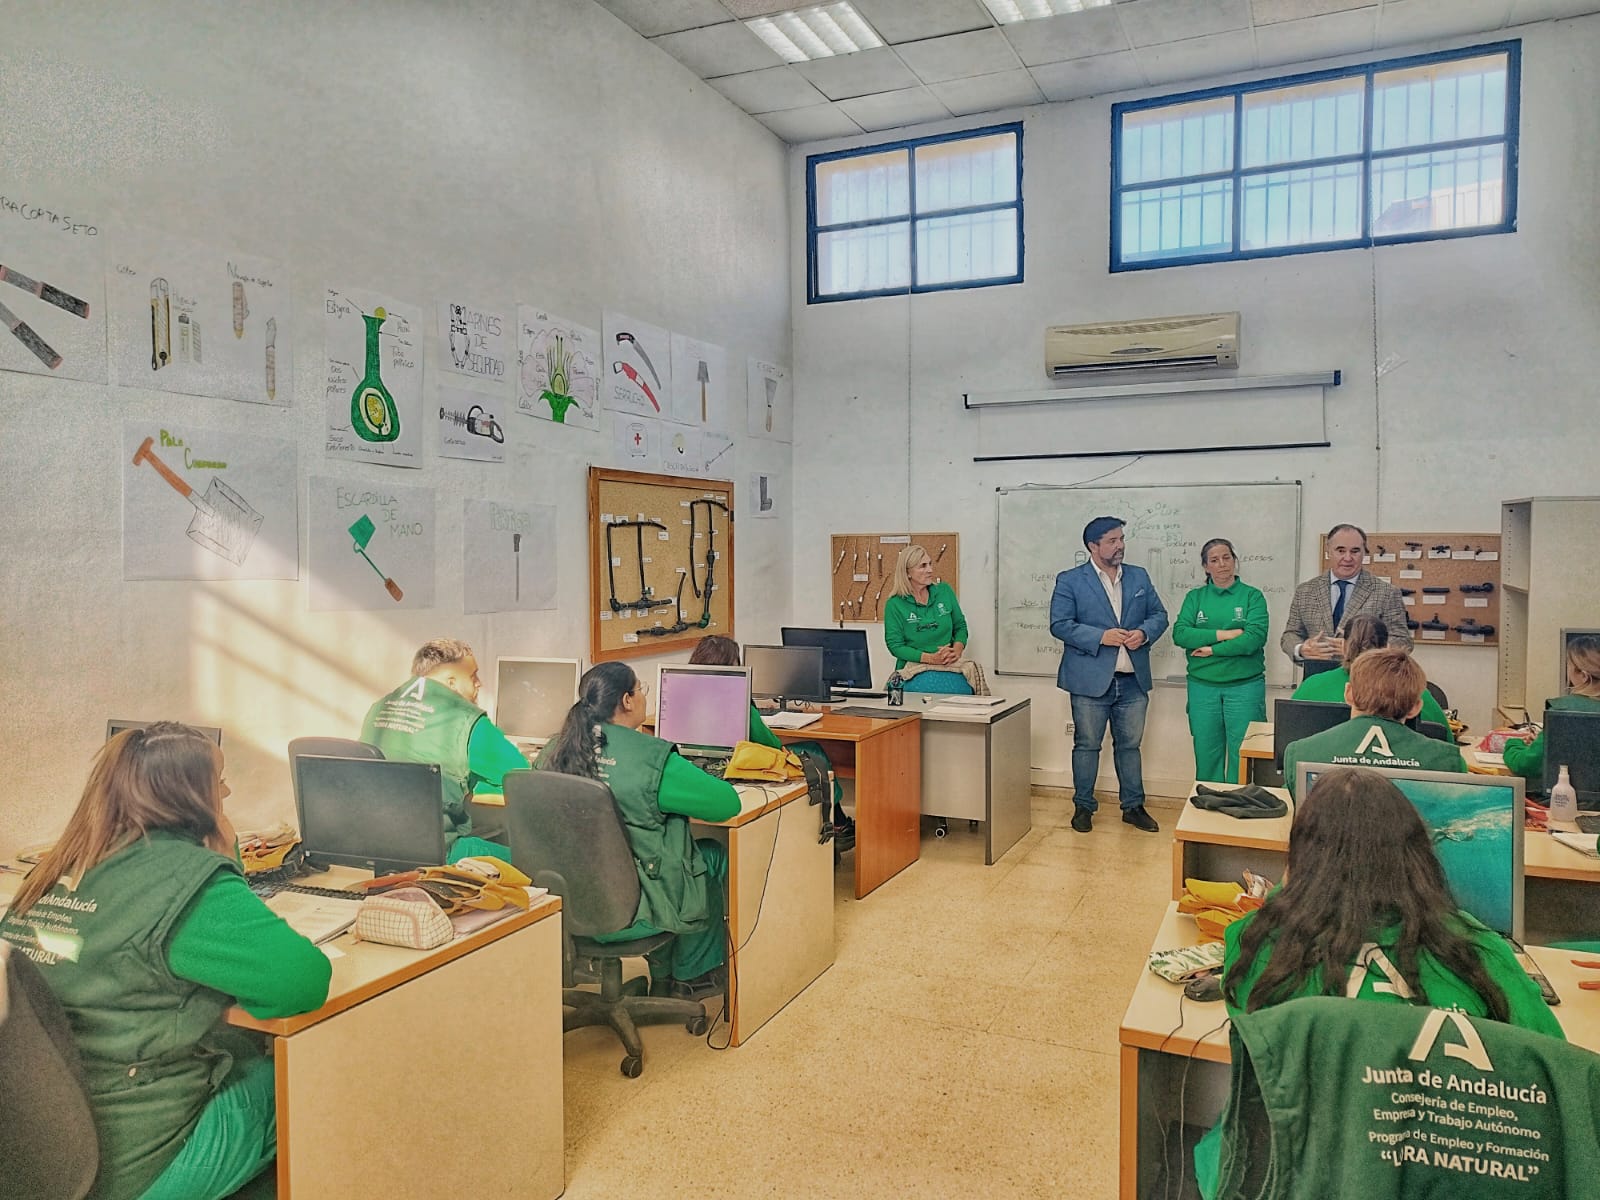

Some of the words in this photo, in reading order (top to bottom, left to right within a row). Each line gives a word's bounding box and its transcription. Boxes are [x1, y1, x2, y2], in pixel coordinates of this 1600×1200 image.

[61, 216, 99, 236] SETO
[473, 333, 489, 349] DE
[381, 508, 400, 523] DE
[390, 522, 424, 538] MANO
[1331, 756, 1358, 764] Junta
[1359, 756, 1372, 765] de
[1373, 758, 1421, 767] Andalucía
[46, 894, 98, 913] Andalucía
[1361, 1066, 1413, 1085] Junta
[1418, 1070, 1443, 1089] de
[1446, 1074, 1547, 1105] Andalucía
[1391, 1092, 1447, 1109] Consejería
[1450, 1099, 1466, 1112] de
[1468, 1102, 1519, 1122] Empleo,
[1418, 1110, 1425, 1121] y
[1427, 1111, 1473, 1130] Trabajo
[1475, 1119, 1541, 1140] Autónomo
[1413, 1129, 1427, 1142] de
[1430, 1133, 1474, 1150] Empleo
[1476, 1143, 1483, 1154] y
[1486, 1142, 1549, 1162] Formación
[1434, 1151, 1540, 1182] NATURAL”
